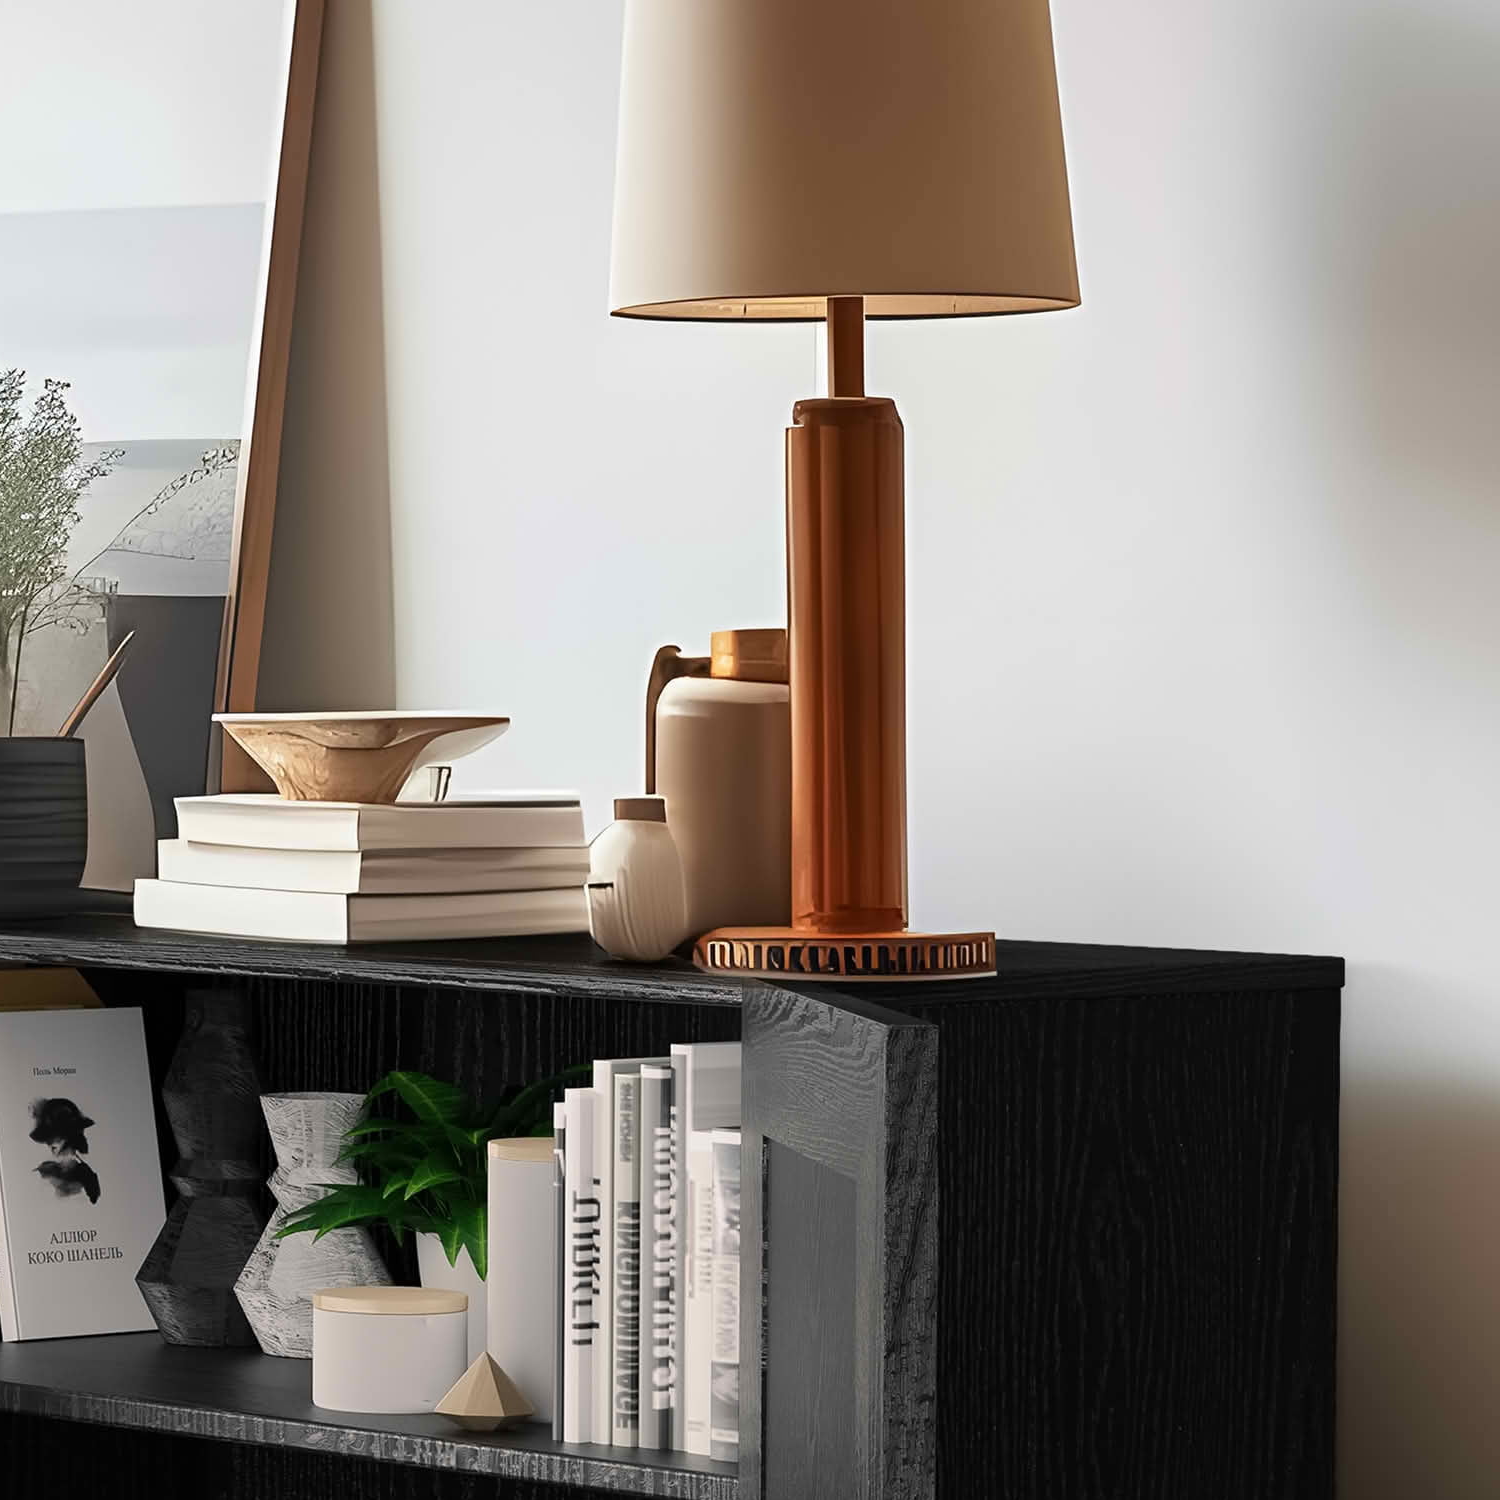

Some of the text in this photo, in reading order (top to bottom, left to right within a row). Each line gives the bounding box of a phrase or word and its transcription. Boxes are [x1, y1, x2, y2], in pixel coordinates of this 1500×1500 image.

[49, 1230, 98, 1245] АЛЛЮР
[27, 1247, 124, 1265] КОКО ШАНЕЛЬ
